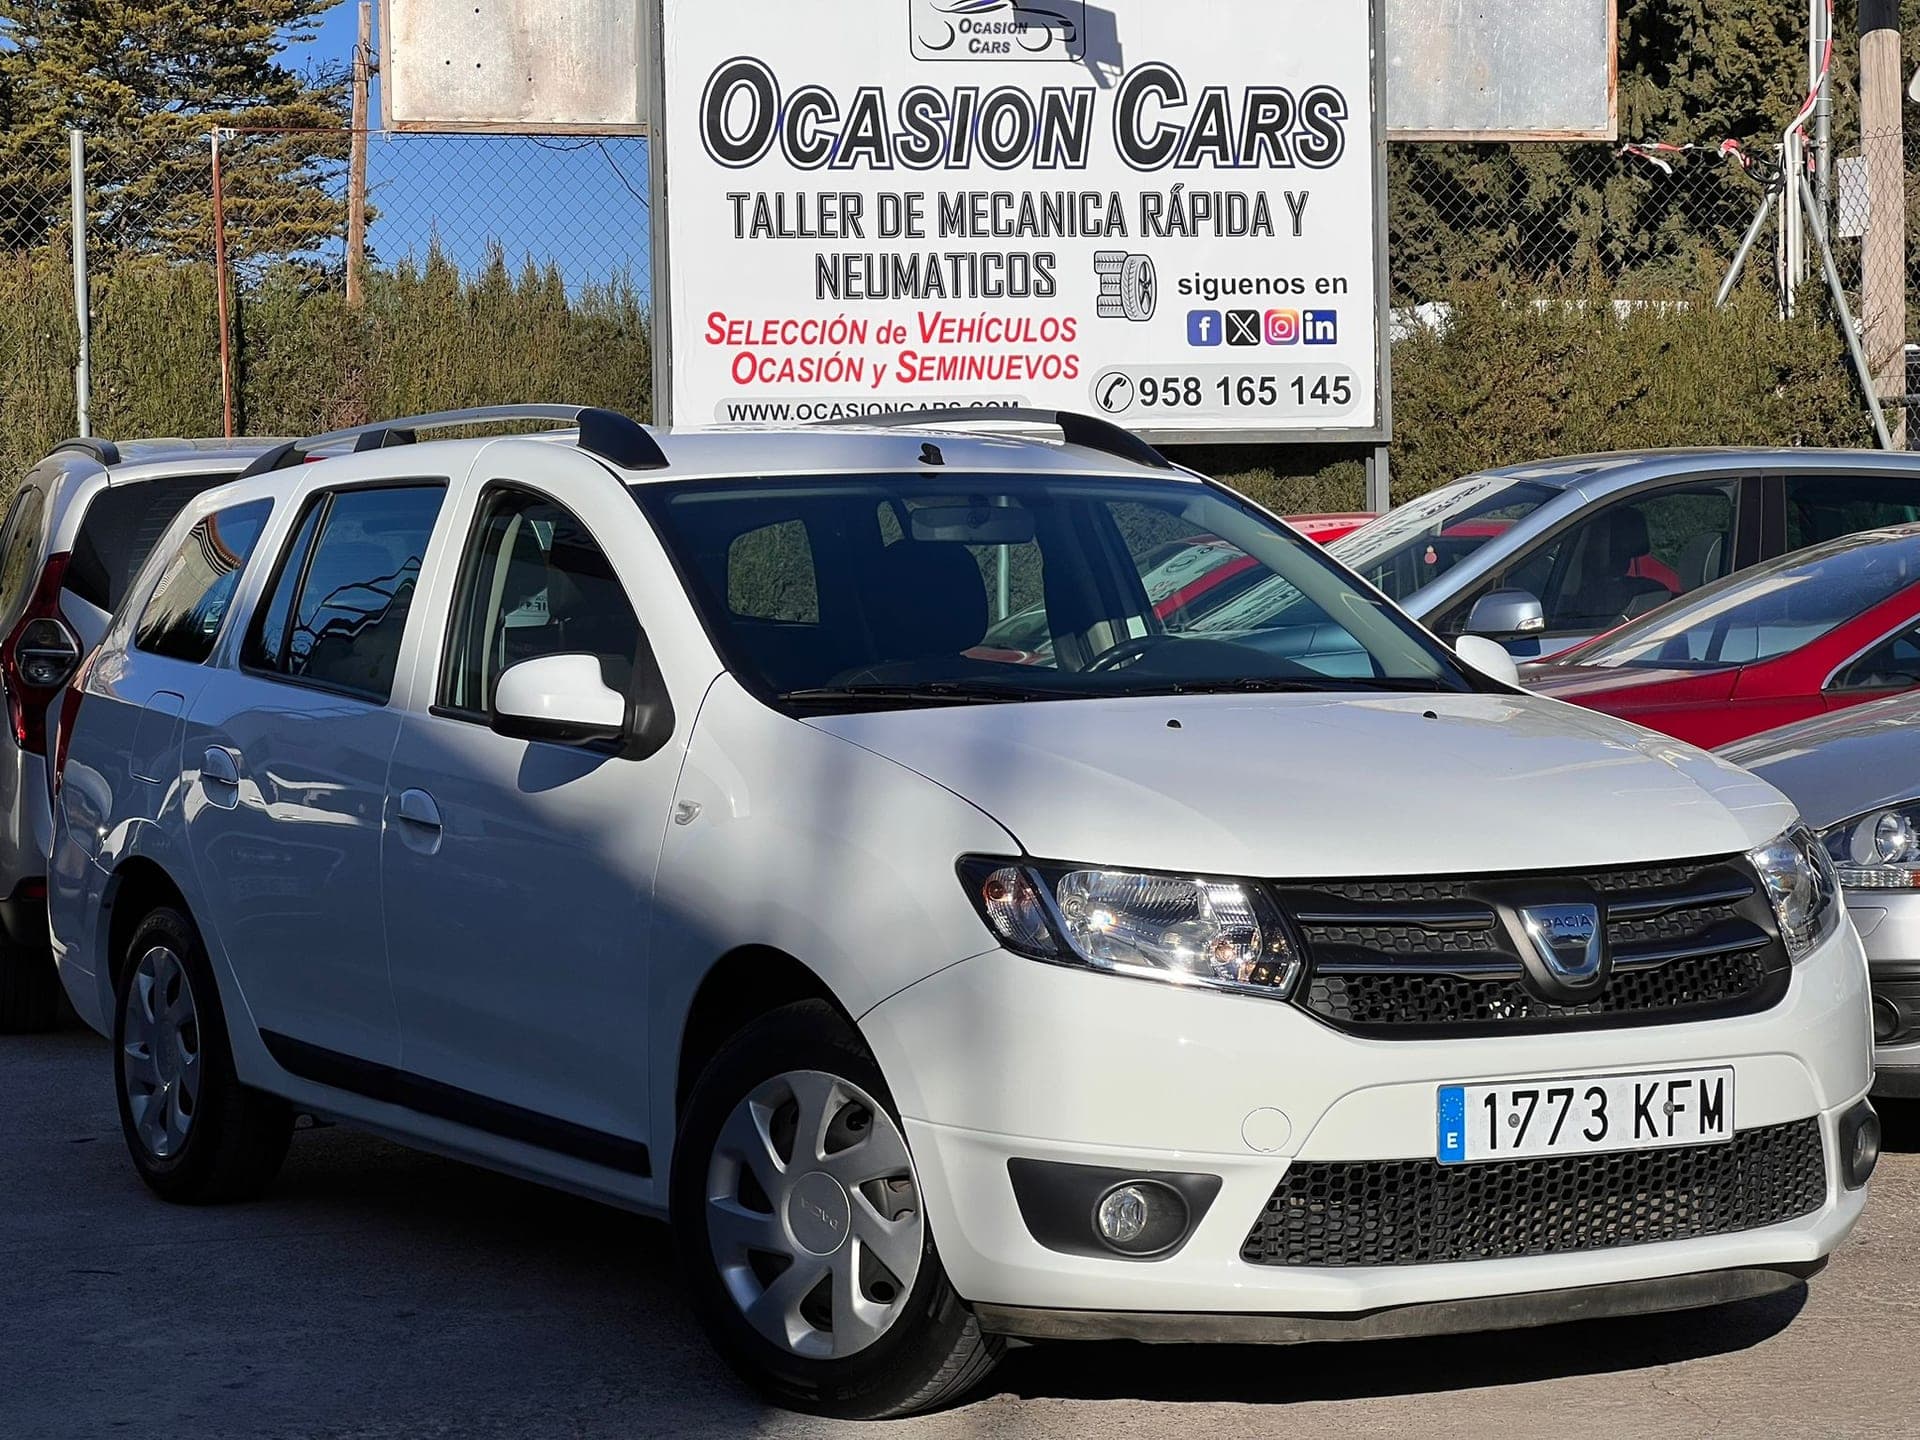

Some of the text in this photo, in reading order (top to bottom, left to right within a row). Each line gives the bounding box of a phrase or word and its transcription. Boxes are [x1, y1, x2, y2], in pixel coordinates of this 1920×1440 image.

[959, 18, 1028, 34] OCASION
[968, 38, 1011, 54] CARS
[700, 56, 1348, 172] OCASION CARS
[726, 183, 1310, 239] TALLER DE MECANICA RÁPIDA Y
[815, 252, 1057, 300] NEUMATICOS
[1178, 273, 1348, 300] siguenos en
[704, 312, 1077, 345] SELECCIÓN de VEHÍCULOS
[732, 350, 1080, 388] OCASIÓN y SEMINUEVOS
[1139, 375, 1351, 407] 958 165 145
[1541, 915, 1592, 928] DACIA
[1484, 1077, 1724, 1149] 1773 KFM
[1447, 1132, 1458, 1148] E
